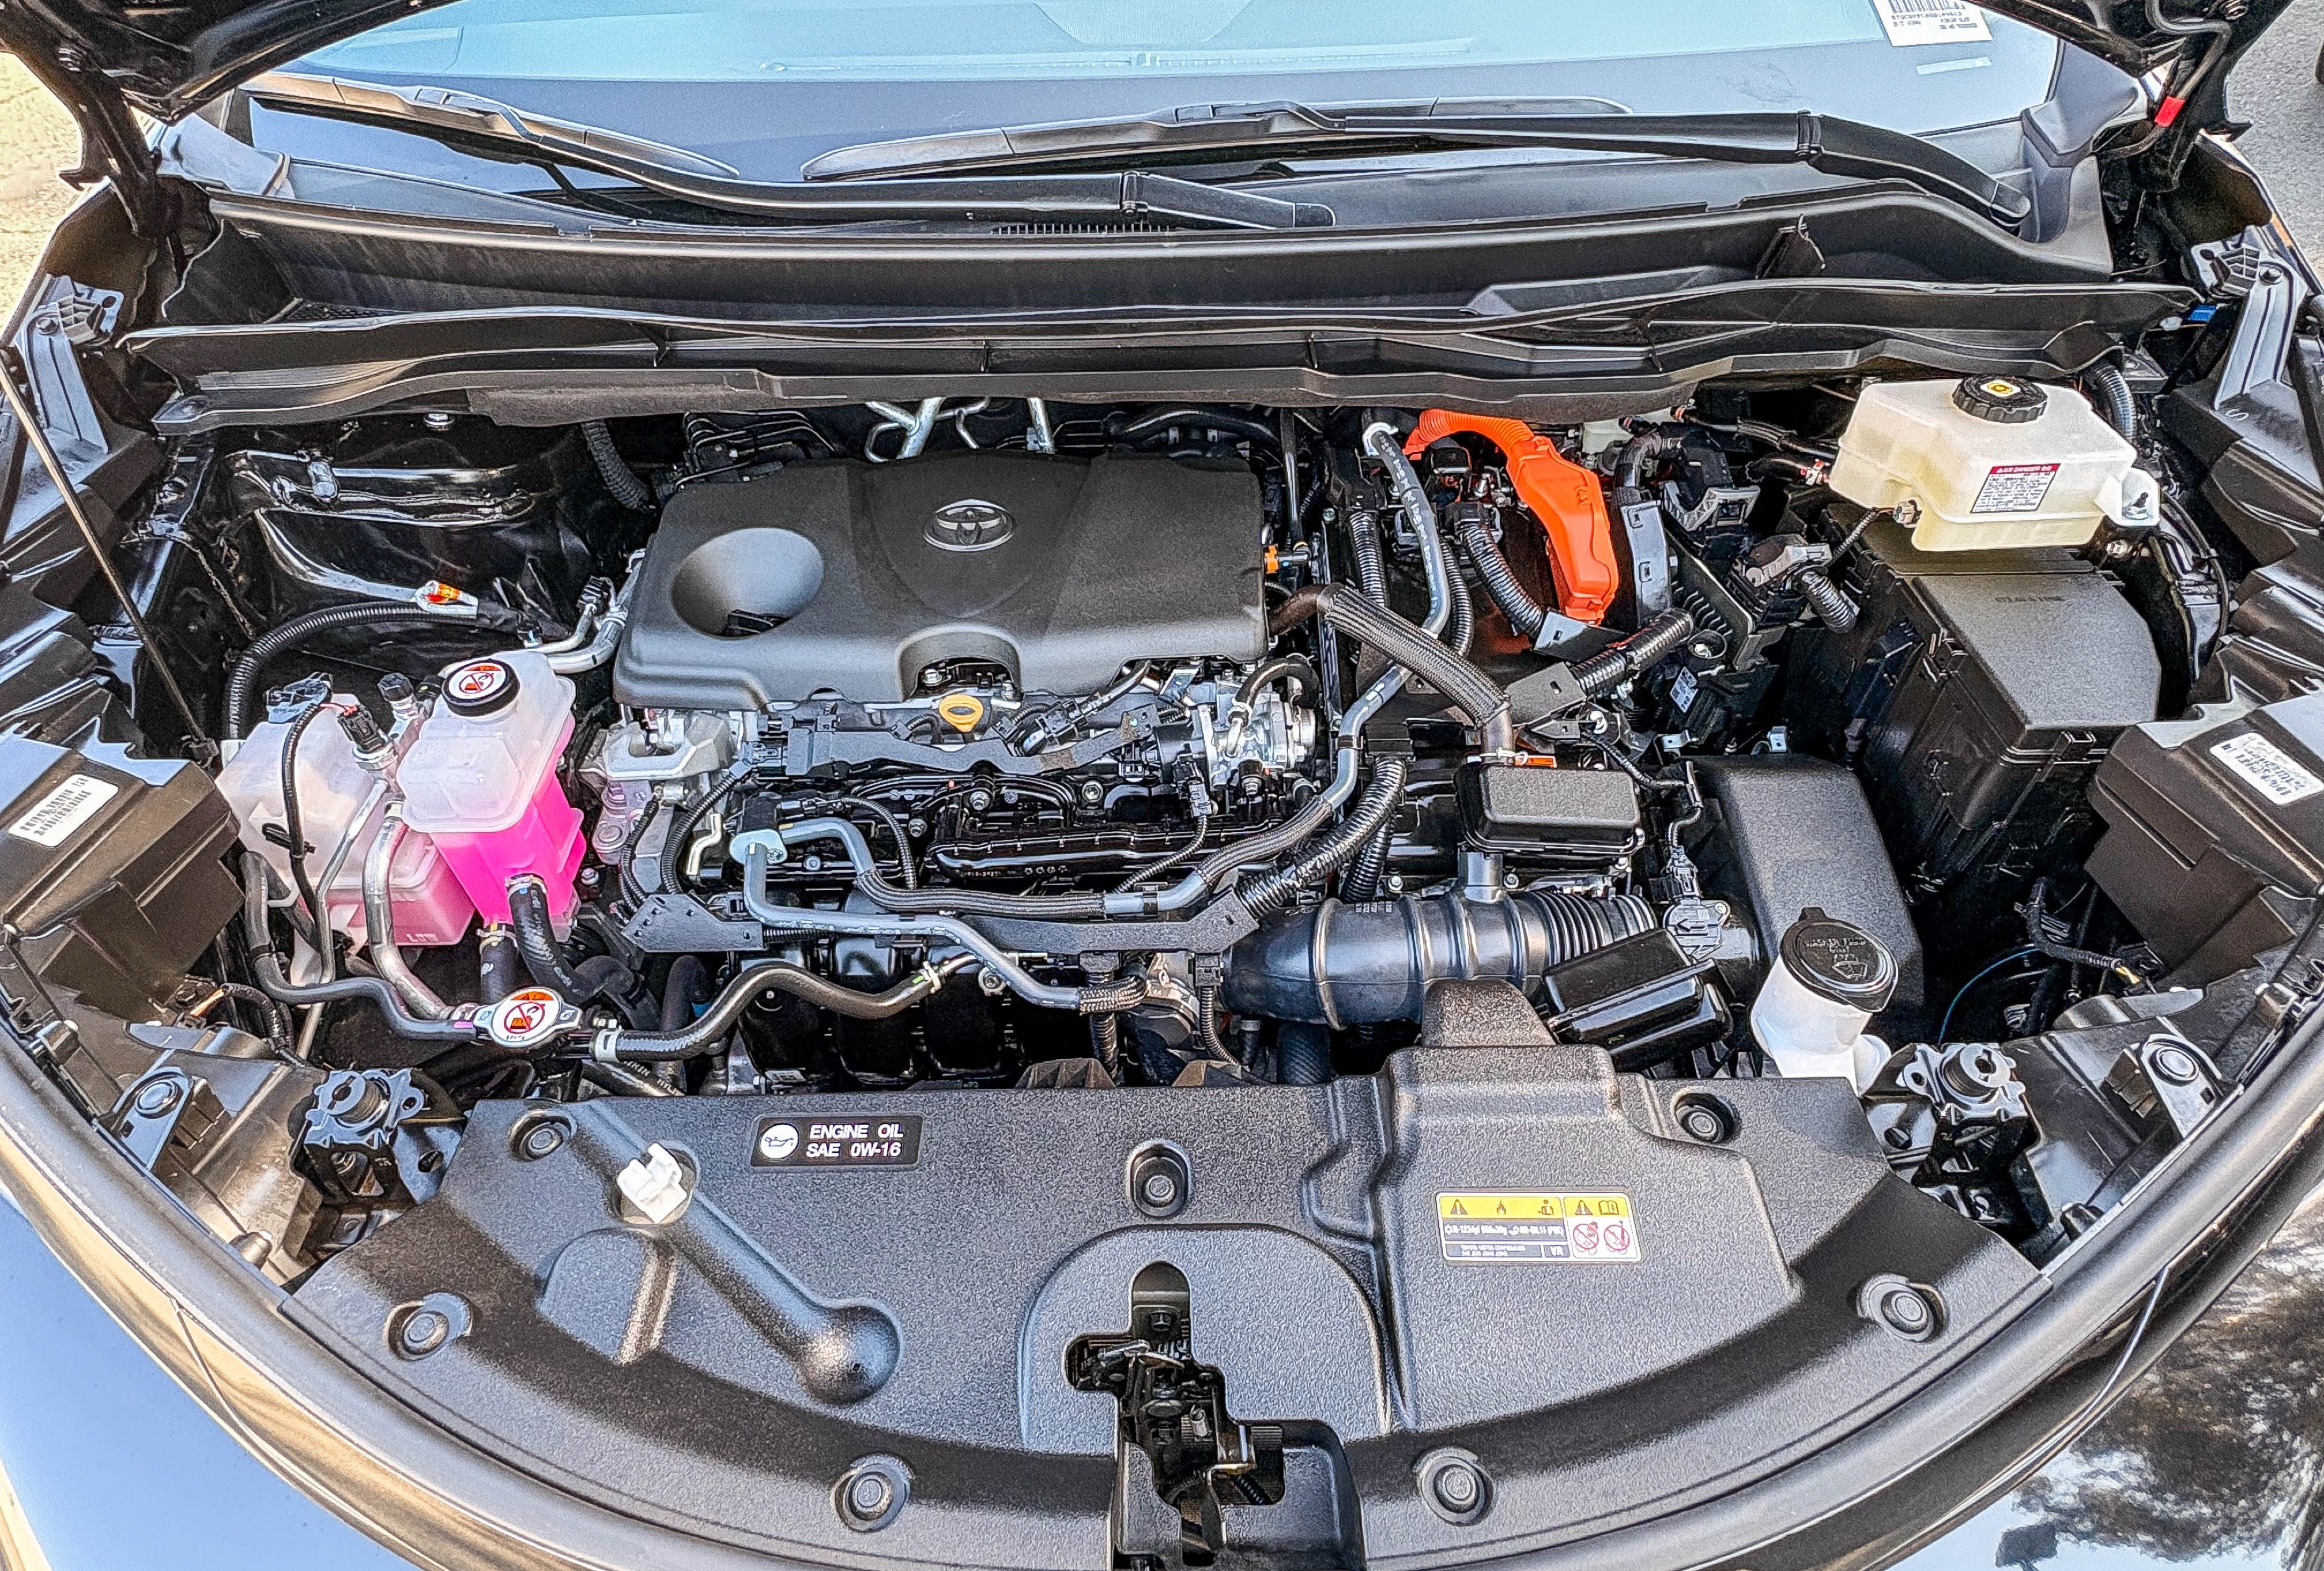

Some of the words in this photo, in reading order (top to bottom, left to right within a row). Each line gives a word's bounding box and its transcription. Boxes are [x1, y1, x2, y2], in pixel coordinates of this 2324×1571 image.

[809, 1124, 869, 1139] ENGINE
[877, 1123, 904, 1139] OIL
[806, 1142, 842, 1158] SAE
[850, 1141, 903, 1157] 0W-16
